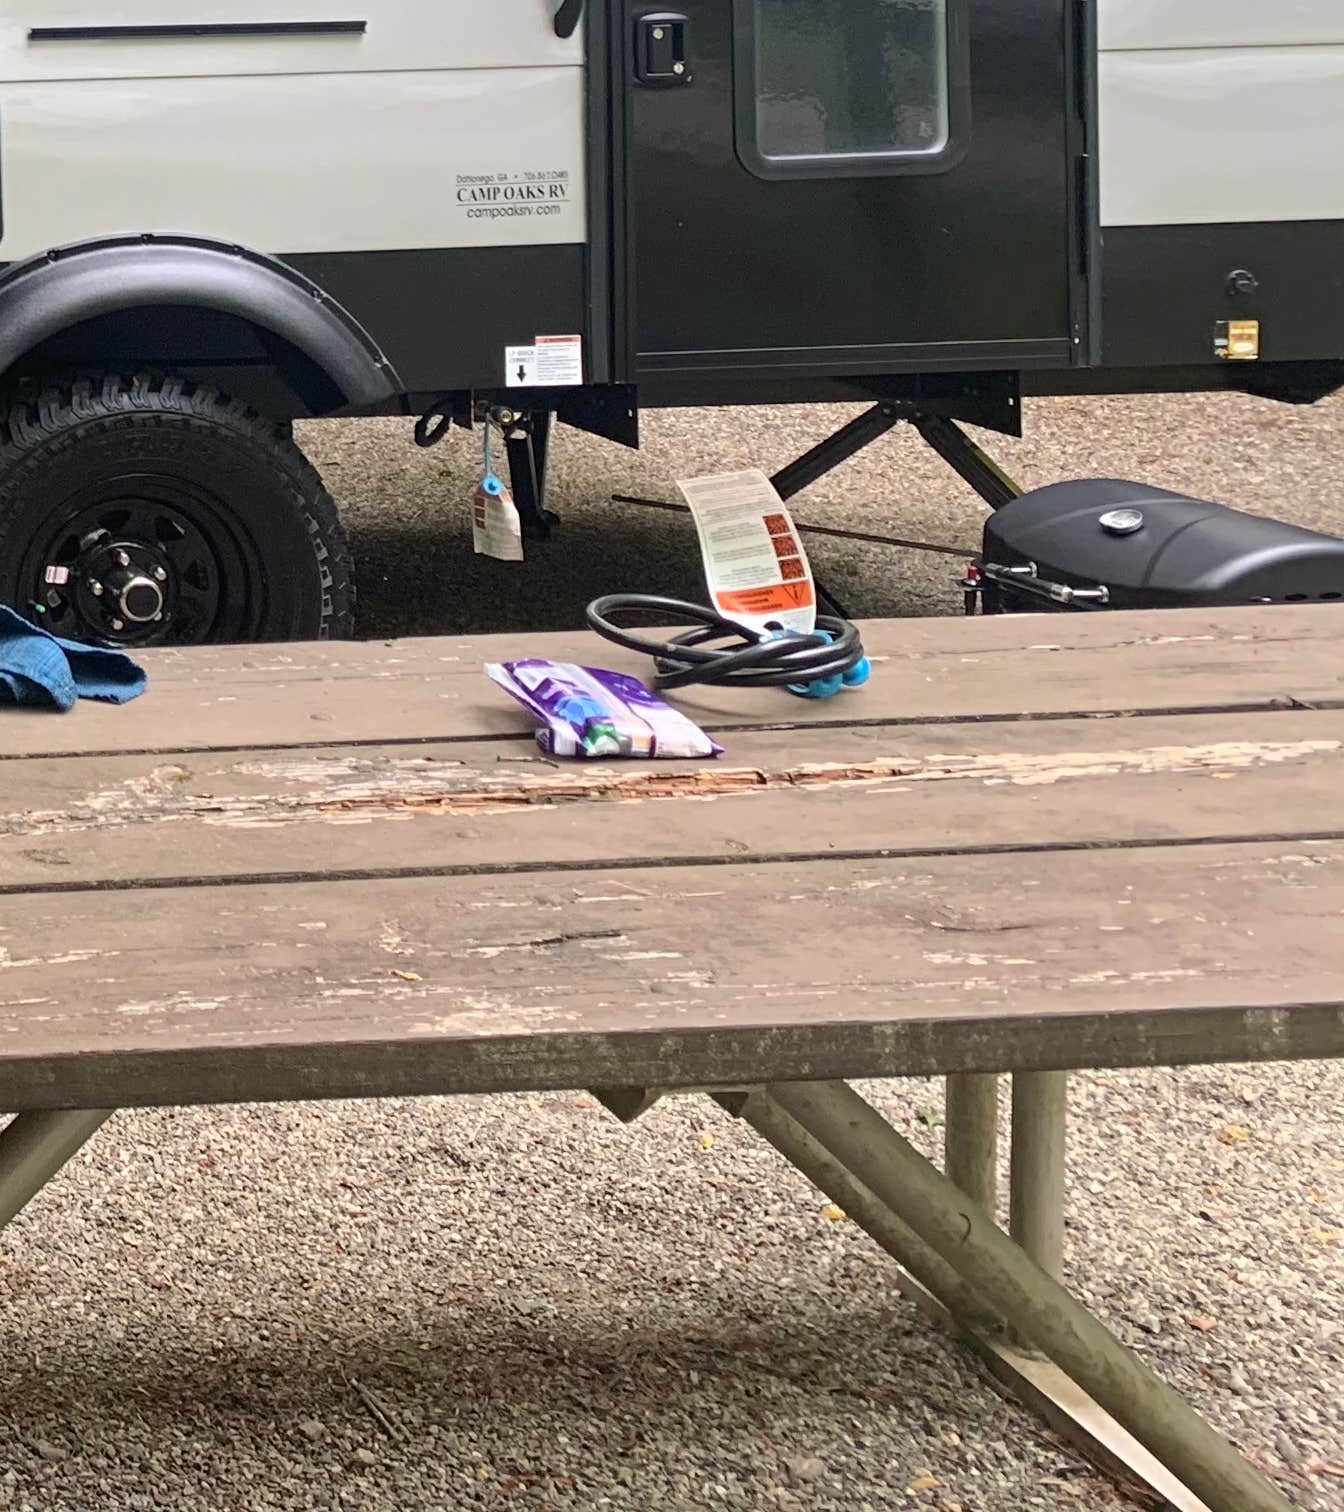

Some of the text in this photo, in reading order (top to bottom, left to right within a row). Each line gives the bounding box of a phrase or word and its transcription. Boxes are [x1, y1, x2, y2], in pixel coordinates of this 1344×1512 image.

[457, 184, 568, 202] CAMP OAKS RV
[467, 205, 561, 219] campoaksrv.com
